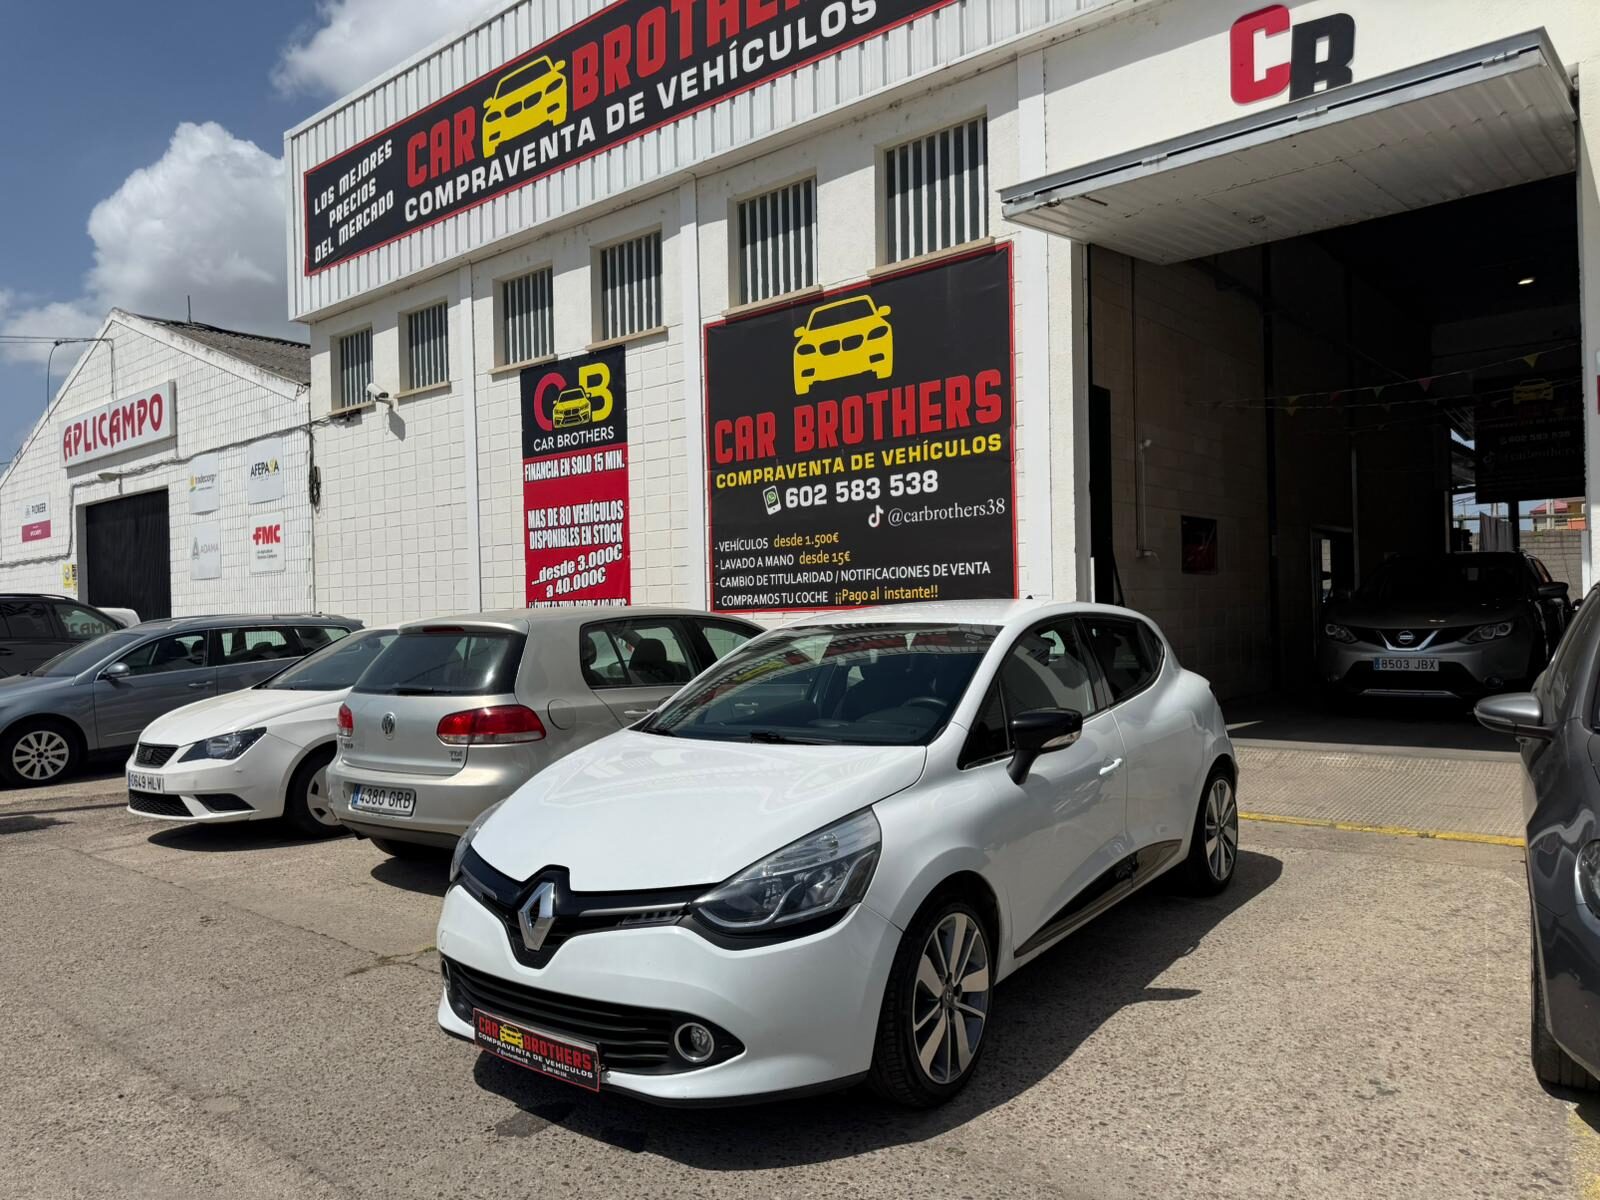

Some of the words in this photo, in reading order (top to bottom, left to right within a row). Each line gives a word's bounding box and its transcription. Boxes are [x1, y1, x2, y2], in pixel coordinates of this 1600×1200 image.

[405, 116, 596, 223] COMPRAVENTA
[606, 91, 646, 134] DE
[656, 0, 877, 110] VEHÍCULOS
[406, 105, 476, 189] CAR
[314, 186, 334, 216] LOS
[339, 139, 392, 195] MEJORES
[329, 177, 376, 228] PRECIOS
[315, 240, 334, 264] DEL
[338, 190, 394, 247] MERCADO
[63, 393, 163, 461] APLICAMPO
[714, 411, 776, 464] CAR
[794, 369, 1001, 453] BROTHERS
[534, 436, 555, 451] CAR
[557, 425, 614, 448] BROTHERS
[524, 460, 559, 482] FINANCIA
[560, 457, 571, 476] EN
[572, 454, 592, 475] SOLO
[593, 452, 604, 472] 15
[605, 450, 625, 470] MIN.
[716, 457, 845, 490] COMPRAVENTA
[850, 452, 875, 471] DE
[881, 433, 1002, 467] VEHÍCULOS
[785, 484, 828, 508] 602
[835, 477, 881, 503] 583
[889, 469, 939, 497] 538
[527, 508, 546, 529] MAS
[547, 507, 558, 526] DE
[560, 505, 571, 525] 80
[572, 499, 624, 524] VEHÍCULOS
[887, 497, 1006, 527] @carbrothers38
[253, 524, 280, 545] FMC
[529, 527, 580, 550] DISPONIBLES
[581, 525, 592, 546] EN
[593, 522, 623, 544] STOCK
[773, 534, 803, 548] desde
[805, 532, 840, 550] 1.500€
[577, 543, 623, 571] 3.000€
[720, 557, 756, 571] LAVADO
[756, 557, 764, 568] A
[765, 554, 794, 568] MANO
[799, 551, 830, 566] desde
[831, 551, 851, 566] 15€
[546, 584, 554, 598] a
[555, 567, 606, 595] 40.000€
[720, 575, 755, 589] CAMBIO
[756, 575, 768, 587] DE
[768, 571, 833, 586] TITULARIDAD
[841, 565, 930, 582] NOTIFICACIONES
[933, 564, 949, 577] DE
[950, 561, 991, 576] VENTA
[721, 592, 781, 607] COMPRAMOS
[781, 592, 794, 605] TU
[796, 590, 828, 604] COCHE
[870, 586, 880, 600] al
[884, 585, 938, 600] instante!!
[1382, 660, 1410, 669] 8503
[1415, 660, 1436, 670] JBX
[359, 788, 386, 806] 4380
[388, 790, 412, 809] GRB
[478, 1032, 531, 1058] COMPRAVENTA
[533, 1054, 543, 1063] DE
[479, 1016, 499, 1039] CAR
[524, 1035, 592, 1071] BROTHERS
